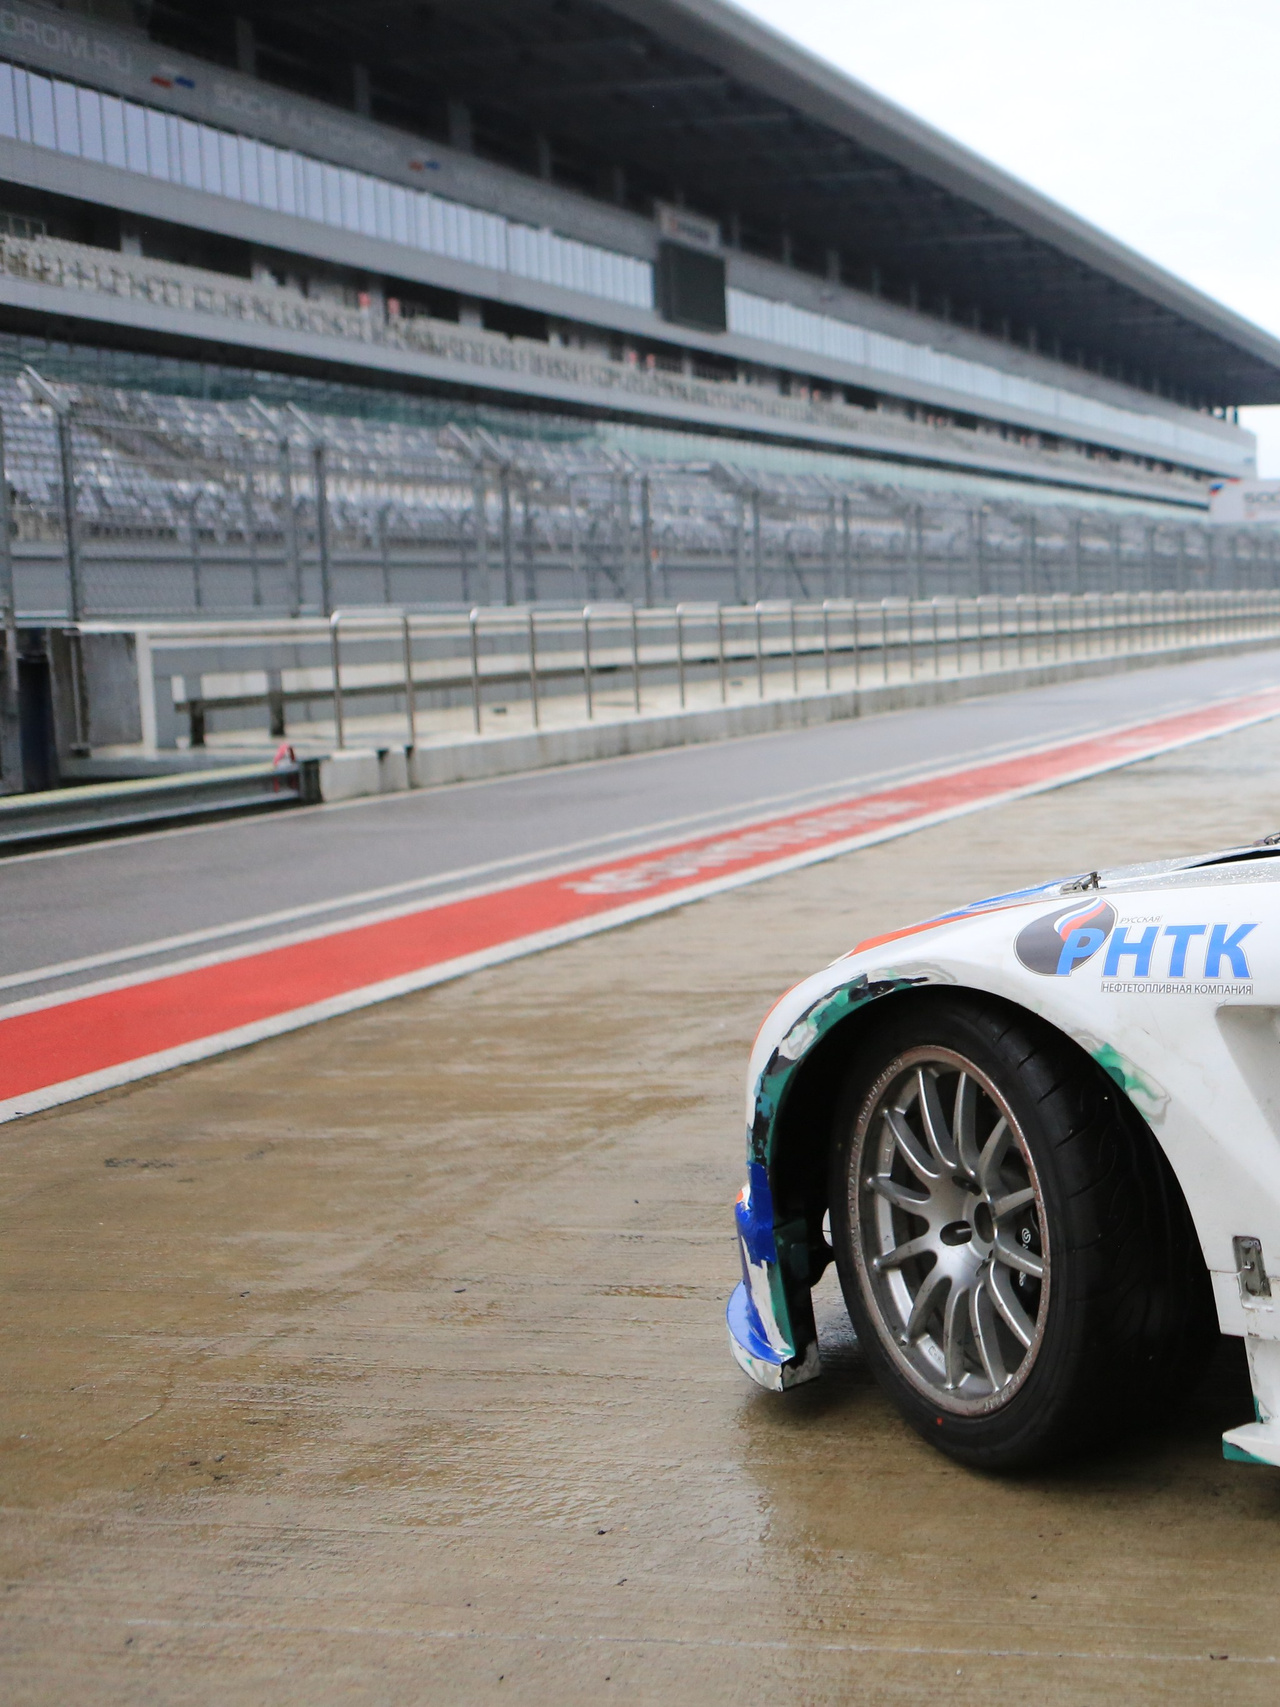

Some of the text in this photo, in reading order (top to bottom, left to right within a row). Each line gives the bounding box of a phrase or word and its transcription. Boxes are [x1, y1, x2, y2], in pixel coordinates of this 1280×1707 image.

[1120, 915, 1162, 924] РУССКАЯ
[1056, 922, 1260, 979] РНТК
[1102, 983, 1251, 995] НЕФТЕТОПЛИВНАЯ КОМПАНИЯ
